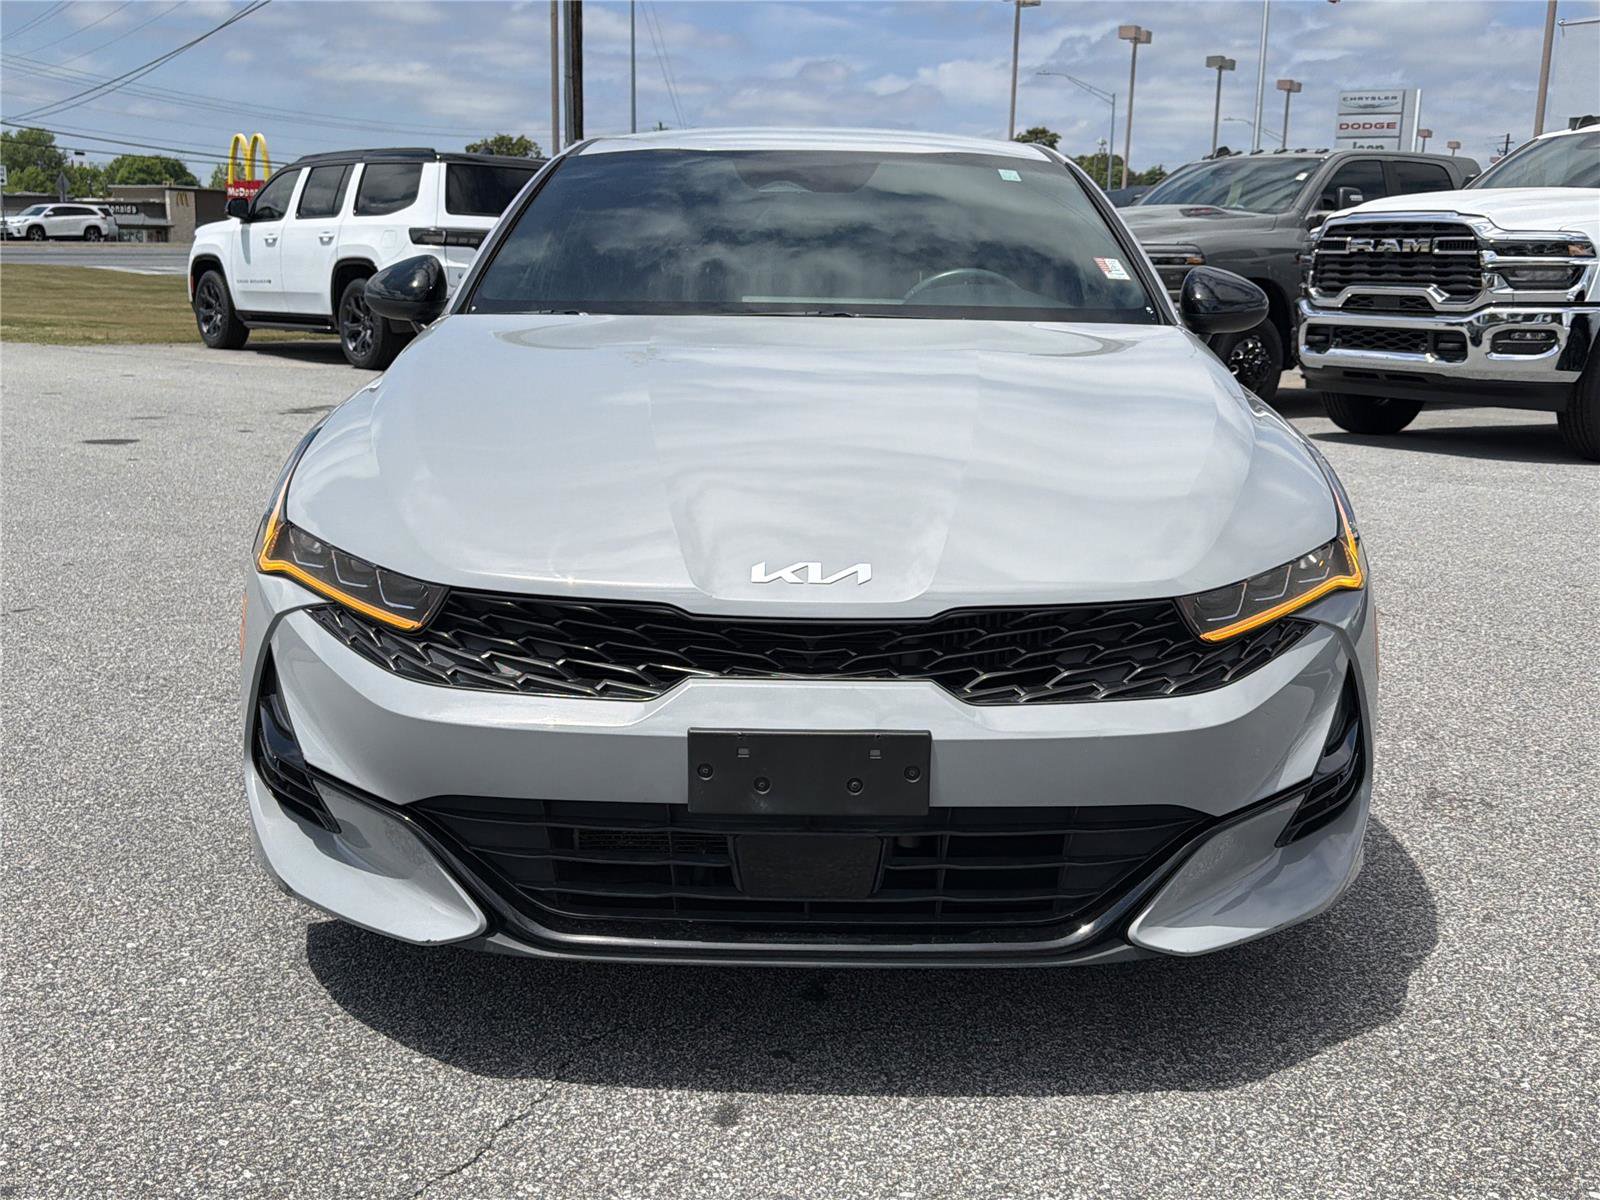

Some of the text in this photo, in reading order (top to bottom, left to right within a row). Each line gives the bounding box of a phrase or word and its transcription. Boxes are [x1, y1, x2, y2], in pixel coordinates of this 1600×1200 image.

[1339, 121, 1397, 130] DODGE
[1350, 238, 1431, 253] RAM
[751, 561, 872, 585] KIA
